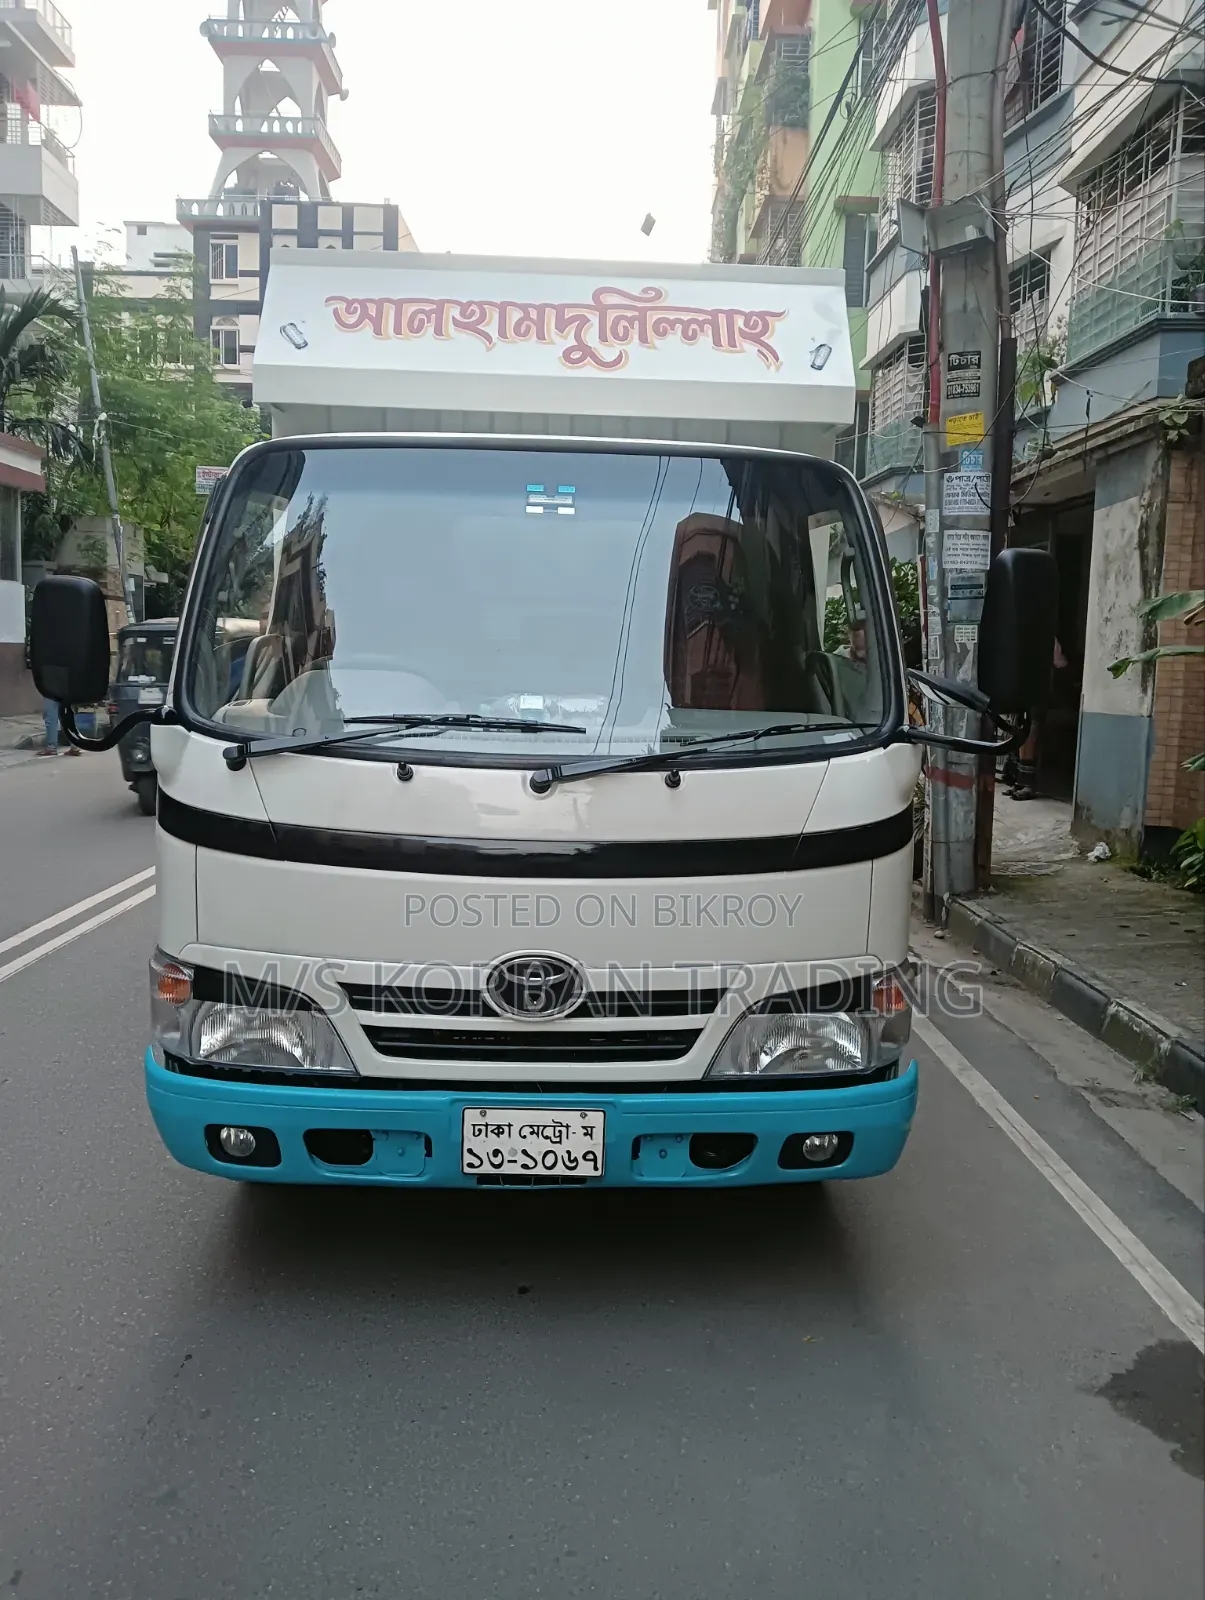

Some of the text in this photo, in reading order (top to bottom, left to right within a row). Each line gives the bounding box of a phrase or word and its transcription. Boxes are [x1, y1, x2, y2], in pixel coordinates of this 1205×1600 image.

[325, 286, 790, 372] আলহামদুলিল্লাহ
[949, 354, 980, 366] টিচার
[471, 1121, 514, 1139] ঢাকা
[466, 1147, 599, 1171] ১৩-১০৬৭
